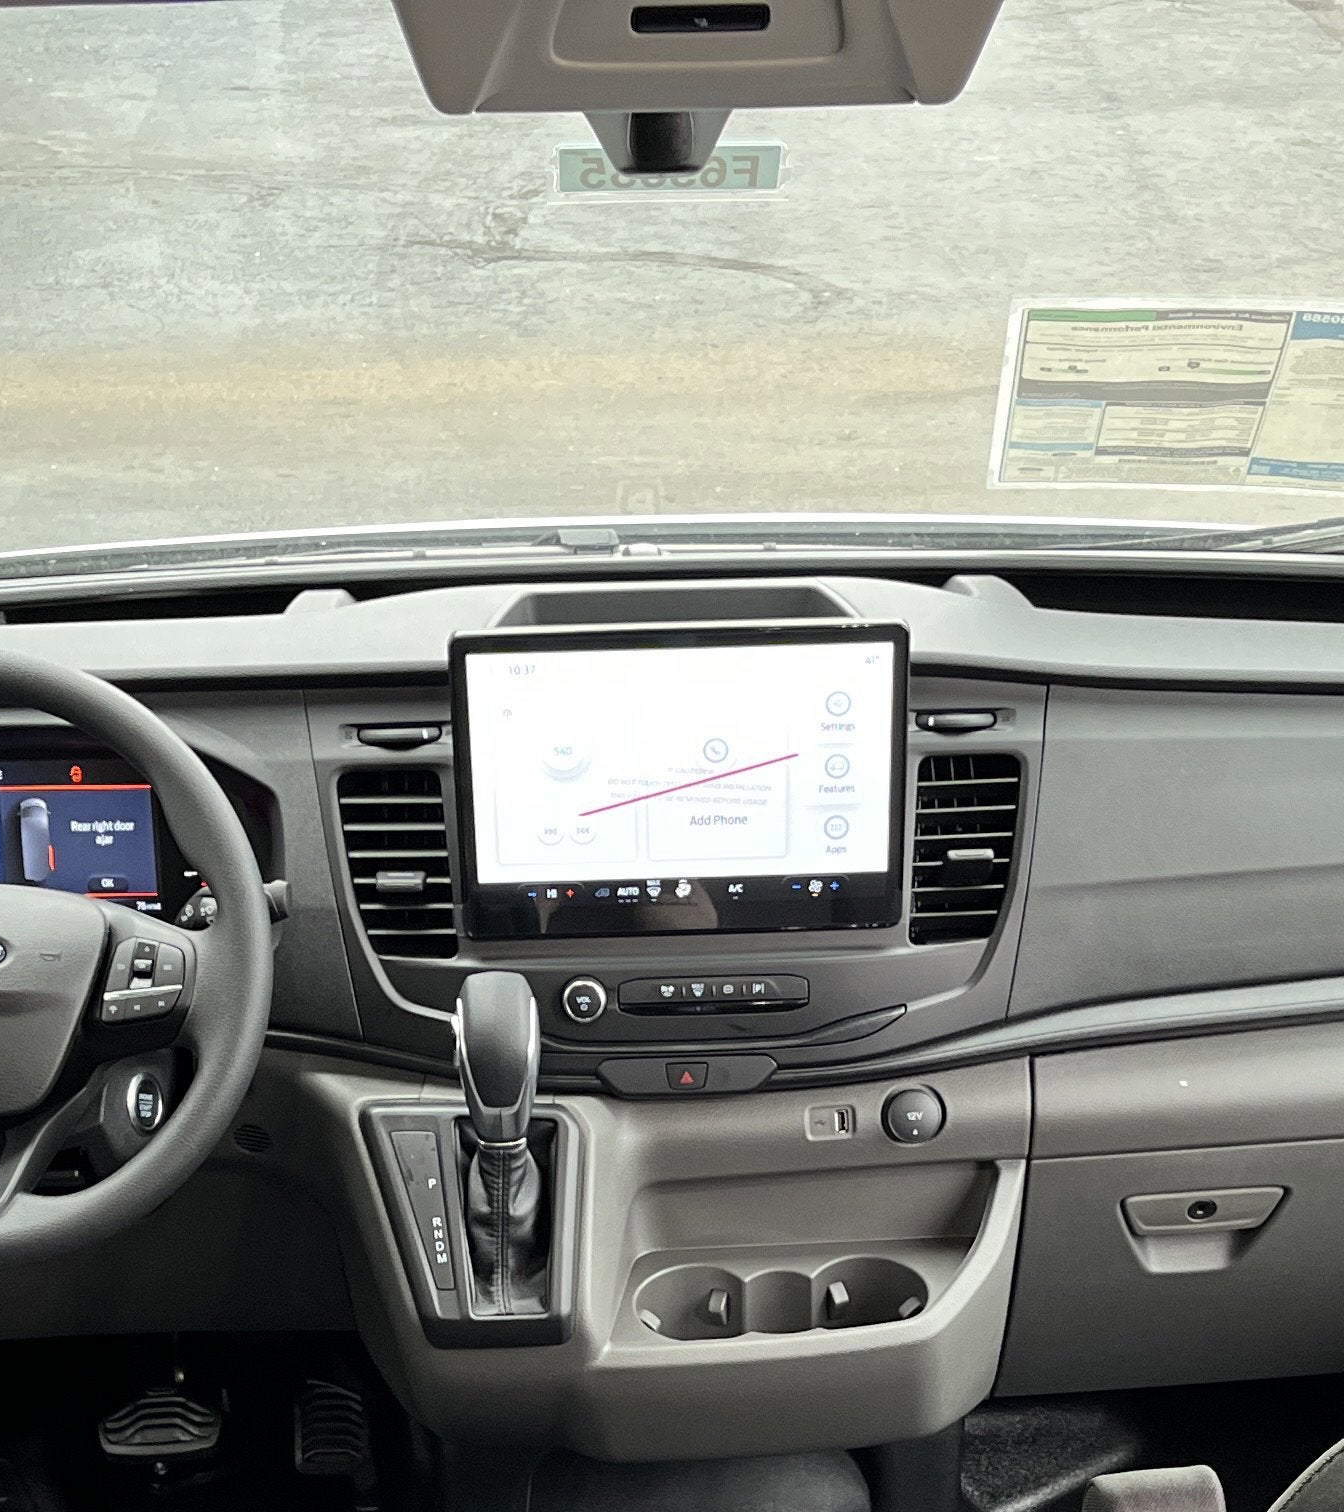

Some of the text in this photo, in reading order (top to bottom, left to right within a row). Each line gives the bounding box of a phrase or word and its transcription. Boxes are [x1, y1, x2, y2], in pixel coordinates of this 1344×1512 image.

[821, 722, 856, 732] Settings
[819, 784, 856, 793] Features
[689, 814, 748, 826] Add Phone
[70, 820, 135, 833] Rear right door
[95, 834, 114, 846] ajar
[825, 845, 847, 854] Apps
[617, 886, 640, 896] AUTO
[728, 883, 744, 893] A/C
[906, 1112, 924, 1121] 12V
[427, 1178, 437, 1189] P
[432, 1217, 442, 1228] R
[433, 1229, 443, 1239] N
[435, 1241, 445, 1251] D
[436, 1253, 448, 1264] M
